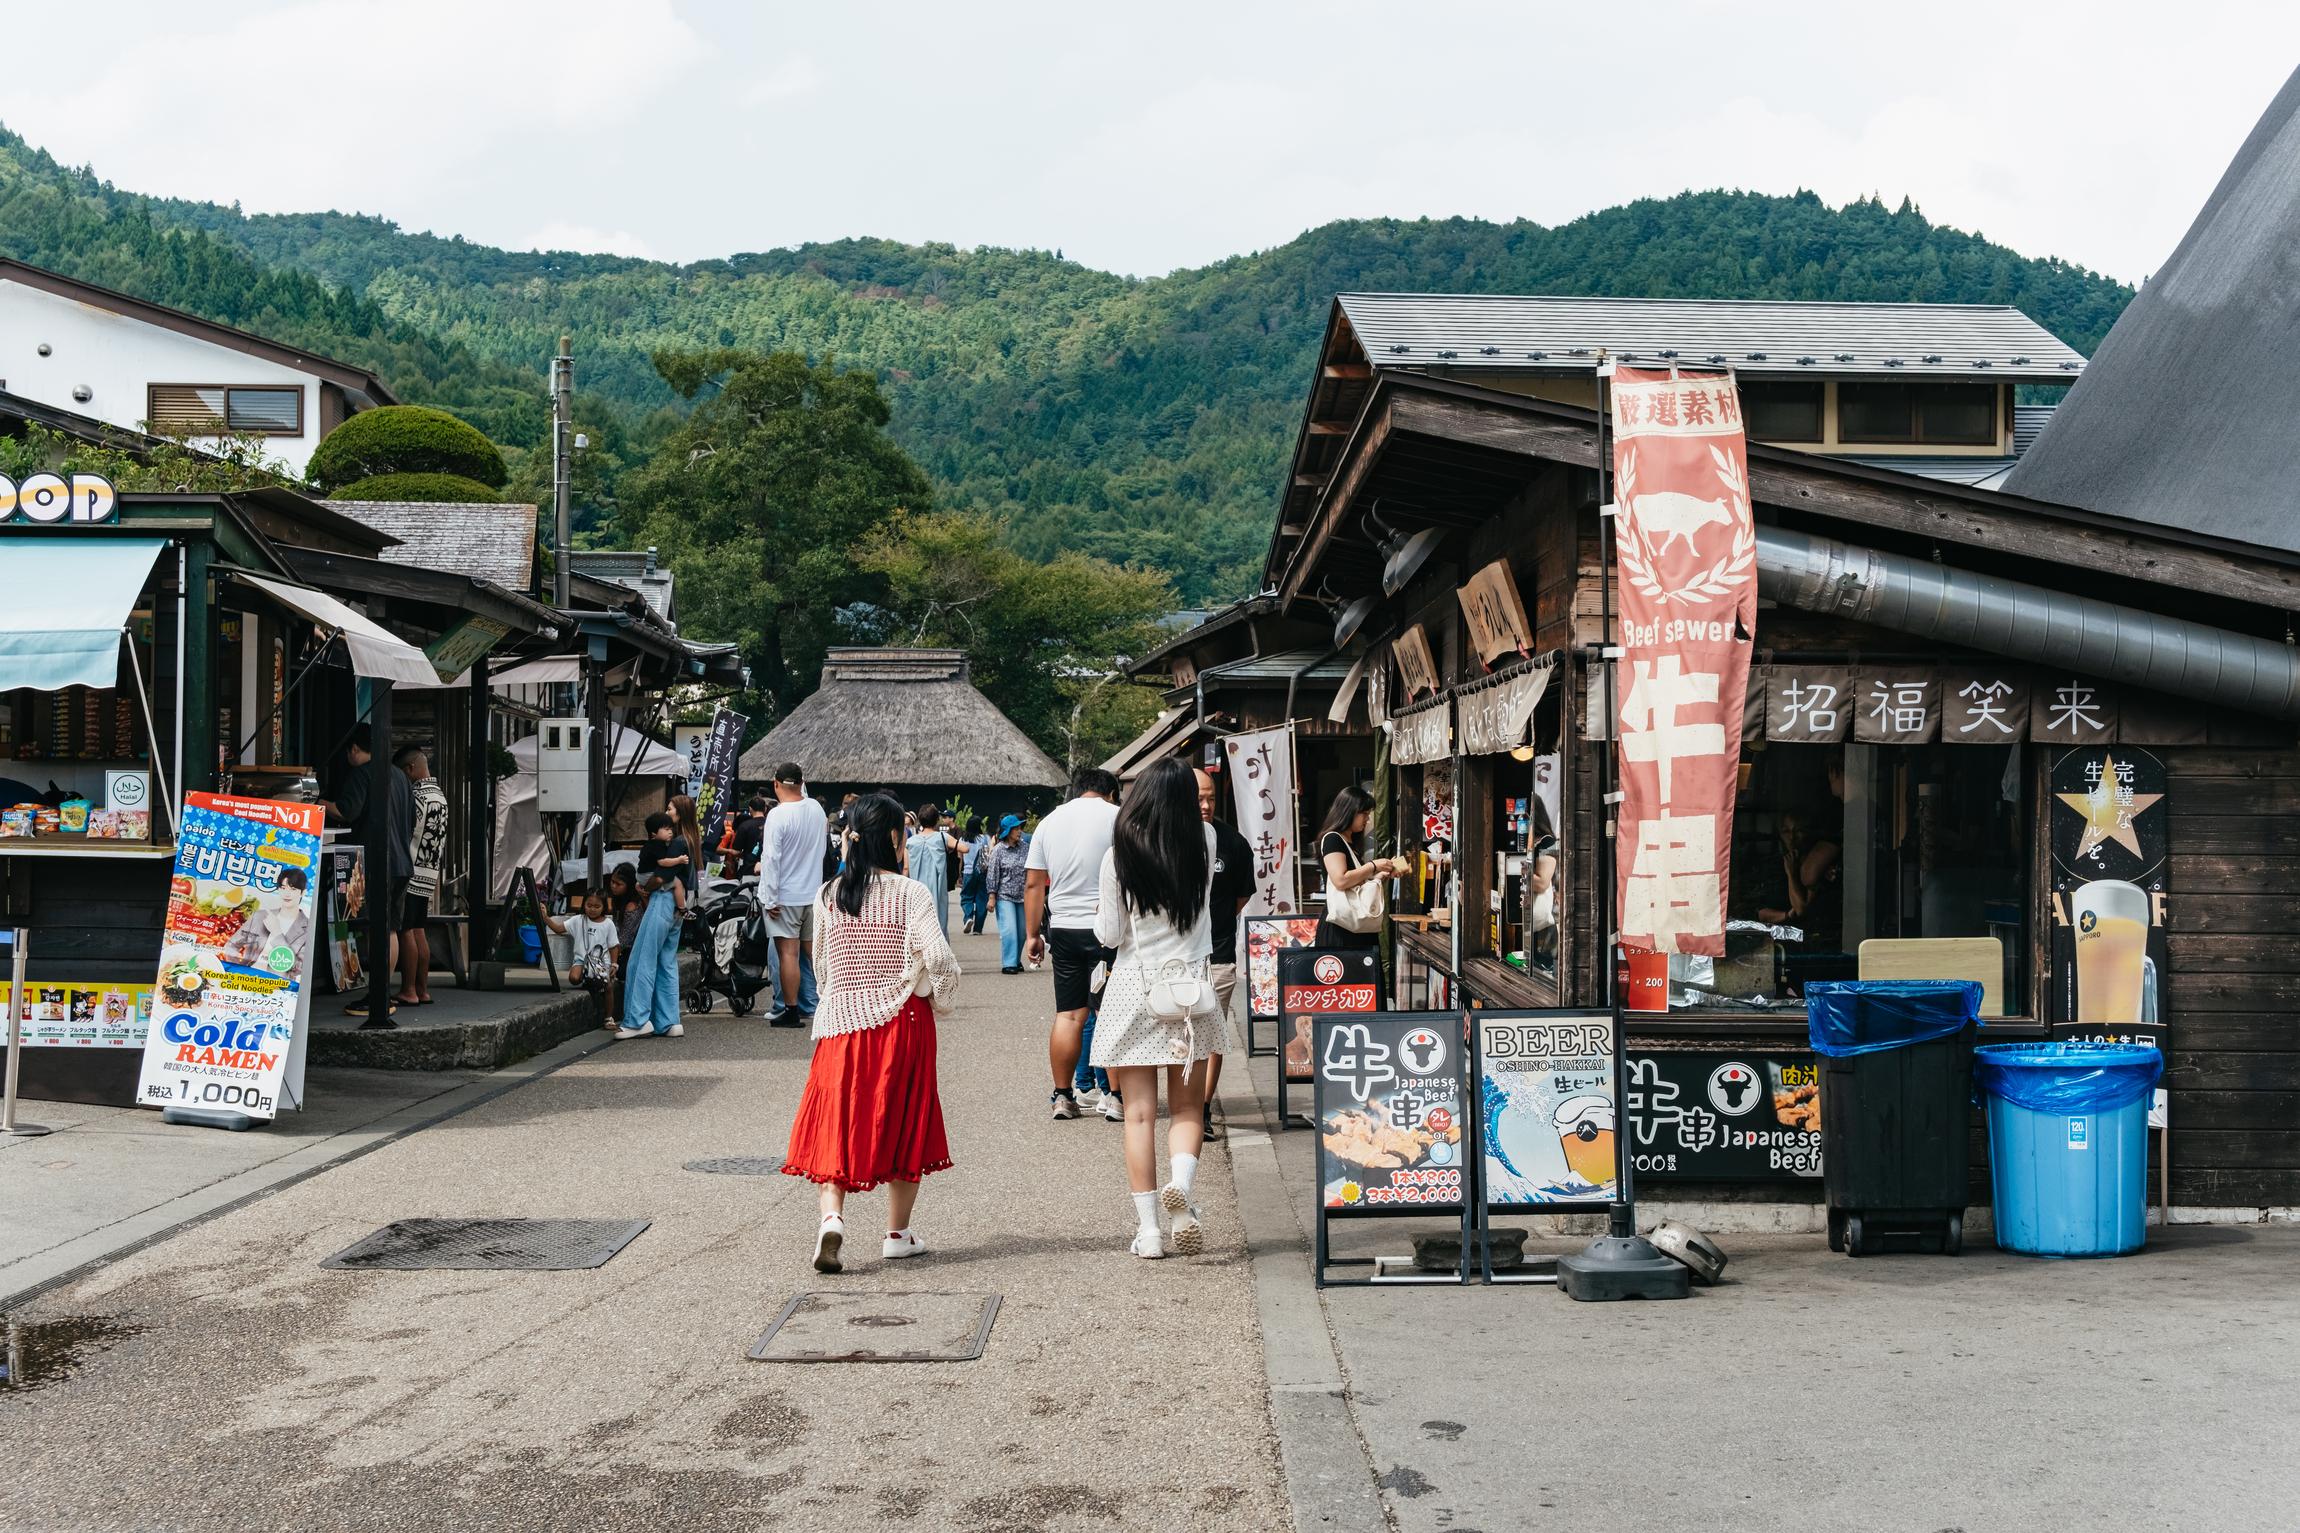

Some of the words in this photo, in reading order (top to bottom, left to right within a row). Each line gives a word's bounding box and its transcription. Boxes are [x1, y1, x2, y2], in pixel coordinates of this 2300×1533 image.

[1623, 619, 1660, 648] Beef
[709, 719, 728, 772] 直売所
[690, 735, 702, 778] うどん
[706, 721, 740, 837] シャインマスカット
[1621, 654, 1725, 953] 牛串
[2112, 761, 2135, 830] 完璧な
[273, 806, 312, 830] No1
[2084, 761, 2106, 870] 生ビールを。
[185, 824, 215, 837] paldo
[195, 846, 282, 892] 비빔면
[205, 970, 235, 981] Korea's
[237, 974, 257, 983] most
[259, 976, 290, 988] popular
[220, 981, 239, 991] Cold
[241, 983, 274, 994] Noodles
[1646, 978, 1663, 987] 200
[208, 1001, 232, 1010] Korean
[1286, 988, 1373, 1009] メンチカツ
[163, 1013, 267, 1051] Cold
[1485, 1024, 1613, 1058] BEER
[176, 1044, 279, 1071] RAMEN
[1322, 1024, 1395, 1102] 牛
[1496, 1058, 1605, 1072] OSHINO-HAKKAI
[147, 1084, 173, 1099] 税込
[1394, 1076, 1456, 1091] Japanese
[1425, 1086, 1455, 1102] Beef
[1554, 1075, 1607, 1094] 生ビール
[1389, 1090, 1424, 1133] 串
[1430, 1111, 1450, 1123] タレ
[1433, 1131, 1448, 1140] or
[1677, 1106, 1716, 1152] 串
[2071, 1121, 2084, 1131] 120
[1720, 1125, 1821, 1150] Japanese
[1631, 1155, 1666, 1171] 00
[1769, 1149, 1821, 1171] Beef
[1391, 1169, 1461, 1186] 1本¥800
[1366, 1187, 1461, 1203] 3本¥2,000
